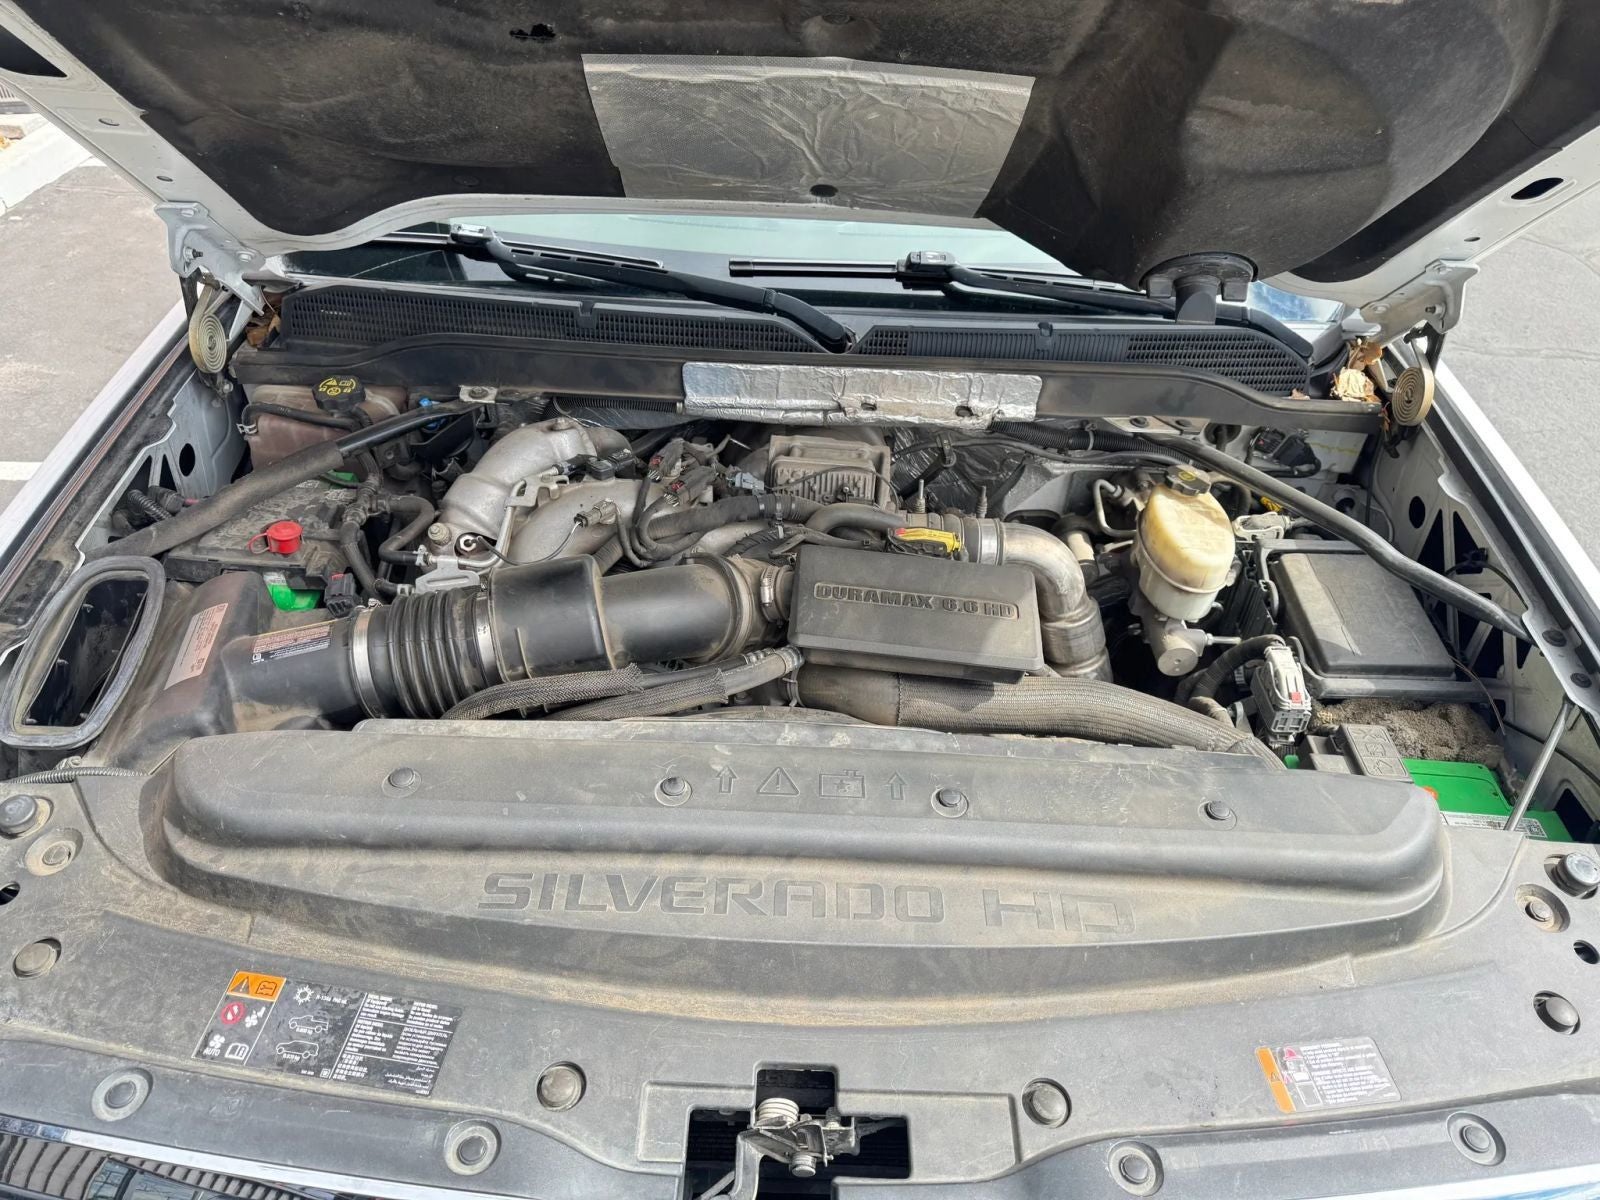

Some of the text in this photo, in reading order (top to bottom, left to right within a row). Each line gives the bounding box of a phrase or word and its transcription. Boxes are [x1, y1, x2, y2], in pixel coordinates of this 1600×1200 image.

[816, 584, 1016, 618] DURAMAX 6.6 HD
[478, 872, 1136, 934] SILVERADO HD
[202, 1047, 221, 1057] AUTO
